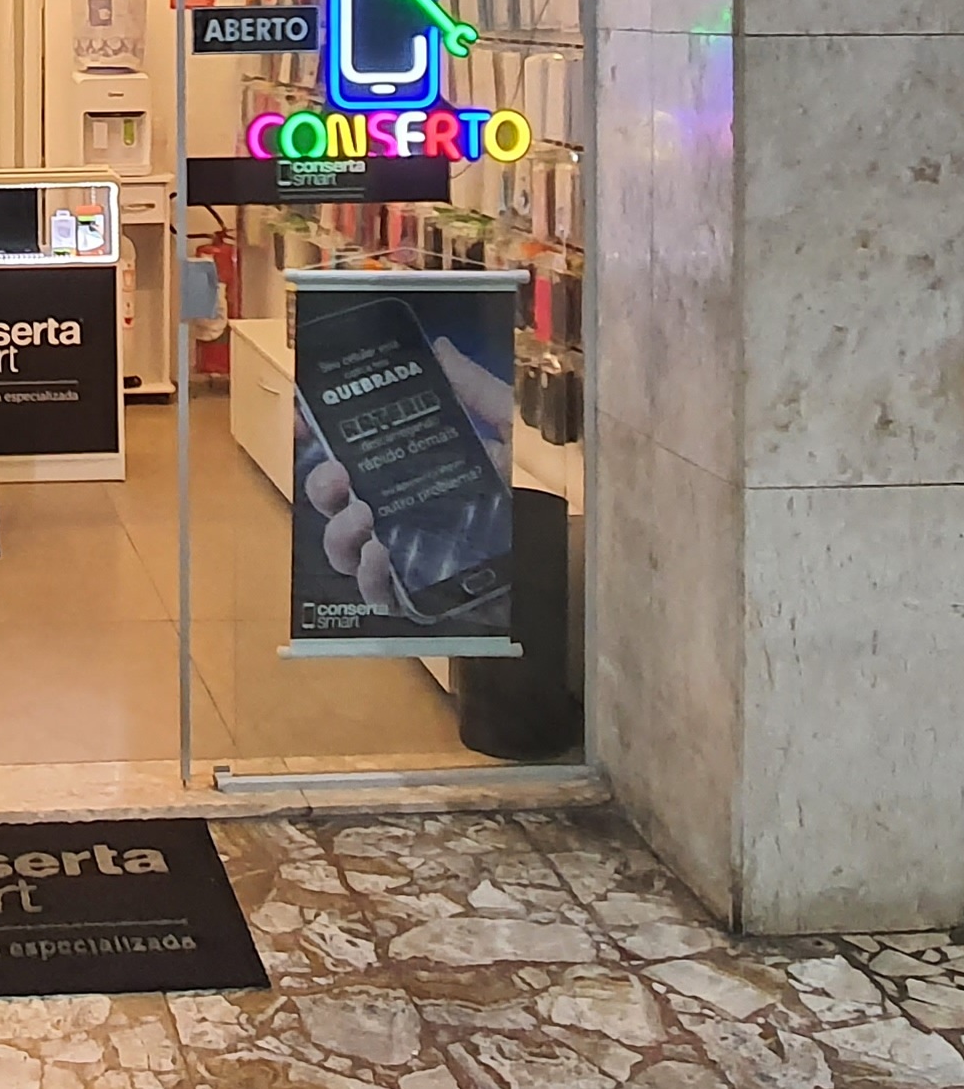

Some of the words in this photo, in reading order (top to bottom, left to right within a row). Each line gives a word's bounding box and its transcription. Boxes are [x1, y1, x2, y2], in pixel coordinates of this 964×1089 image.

[204, 16, 309, 43] ABERTO
[321, 360, 424, 406] QUEBRADA
[408, 427, 459, 454] demais
